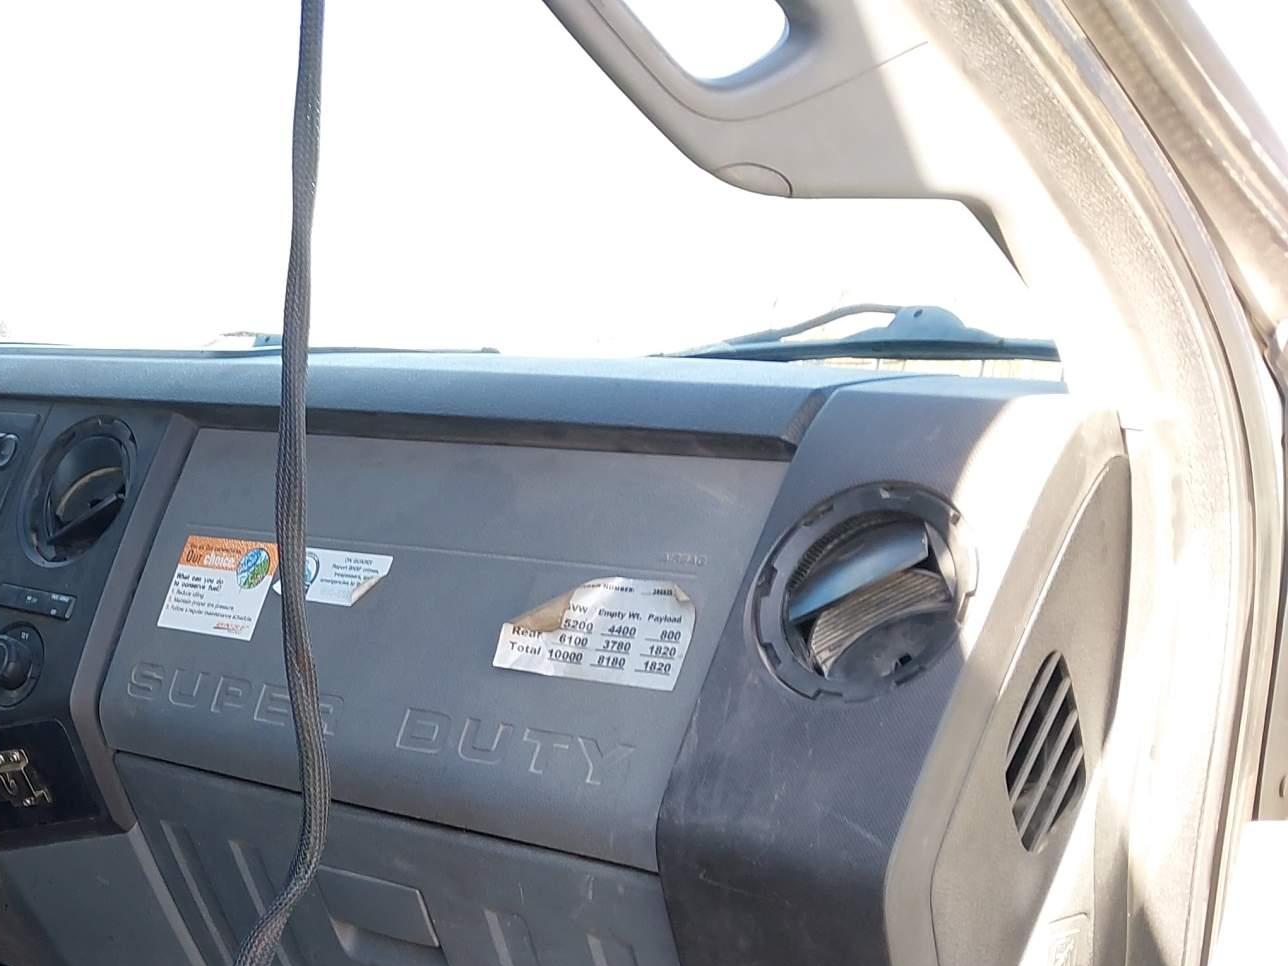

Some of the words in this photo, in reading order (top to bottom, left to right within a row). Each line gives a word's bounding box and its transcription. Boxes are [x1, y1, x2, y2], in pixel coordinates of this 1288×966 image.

[186, 549, 203, 562] Our
[599, 608, 626, 620] Empty
[628, 610, 642, 621] Wt.
[648, 613, 682, 624] Payload
[564, 619, 593, 632] 5200
[608, 625, 637, 636] 4400
[660, 630, 681, 641] 800
[509, 640, 542, 655] Total
[548, 648, 583, 662] 10000
[597, 655, 626, 667] 8180
[644, 660, 672, 673] 1820
[559, 633, 588, 647] 6100
[603, 640, 631, 651] 3780
[649, 645, 677, 657] 1820
[395, 707, 636, 786] DUTY
